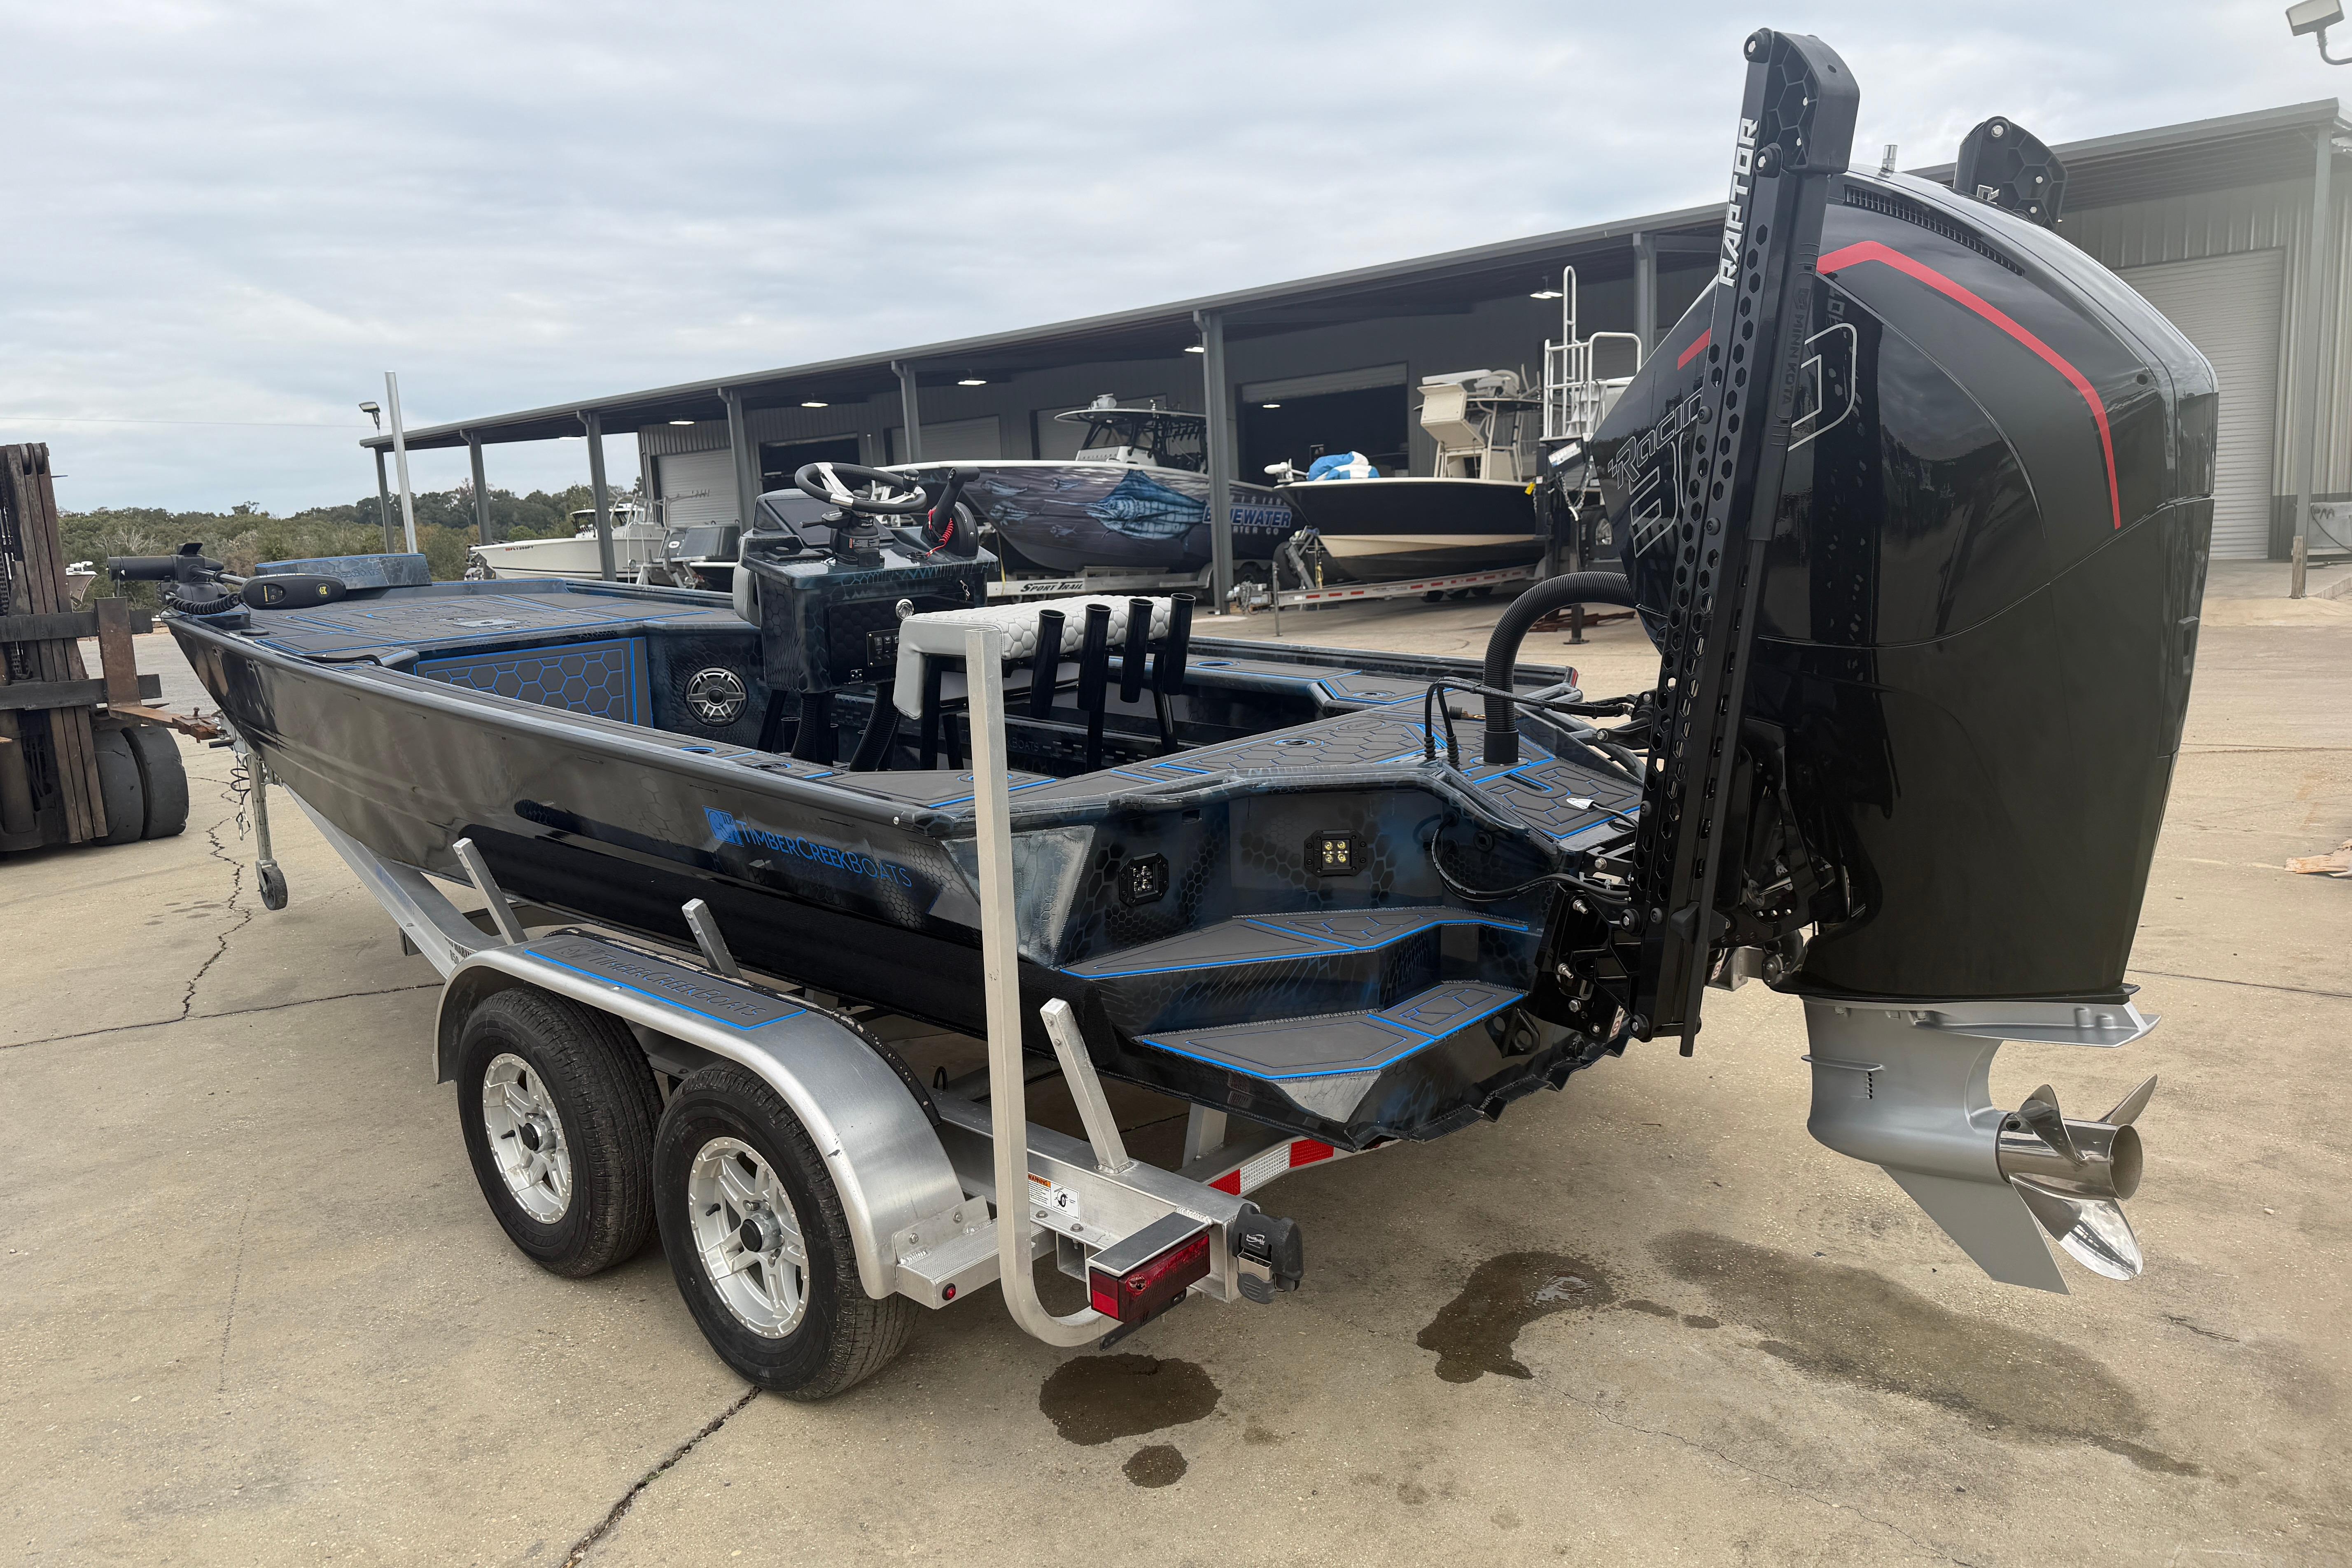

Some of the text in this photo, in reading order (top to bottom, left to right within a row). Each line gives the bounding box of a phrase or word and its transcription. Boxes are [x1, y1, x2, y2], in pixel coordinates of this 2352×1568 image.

[1718, 118, 1759, 287] RAPTOR
[1781, 314, 1805, 405] MINN KOTA
[1020, 581, 1083, 592] SPORT TRAIL
